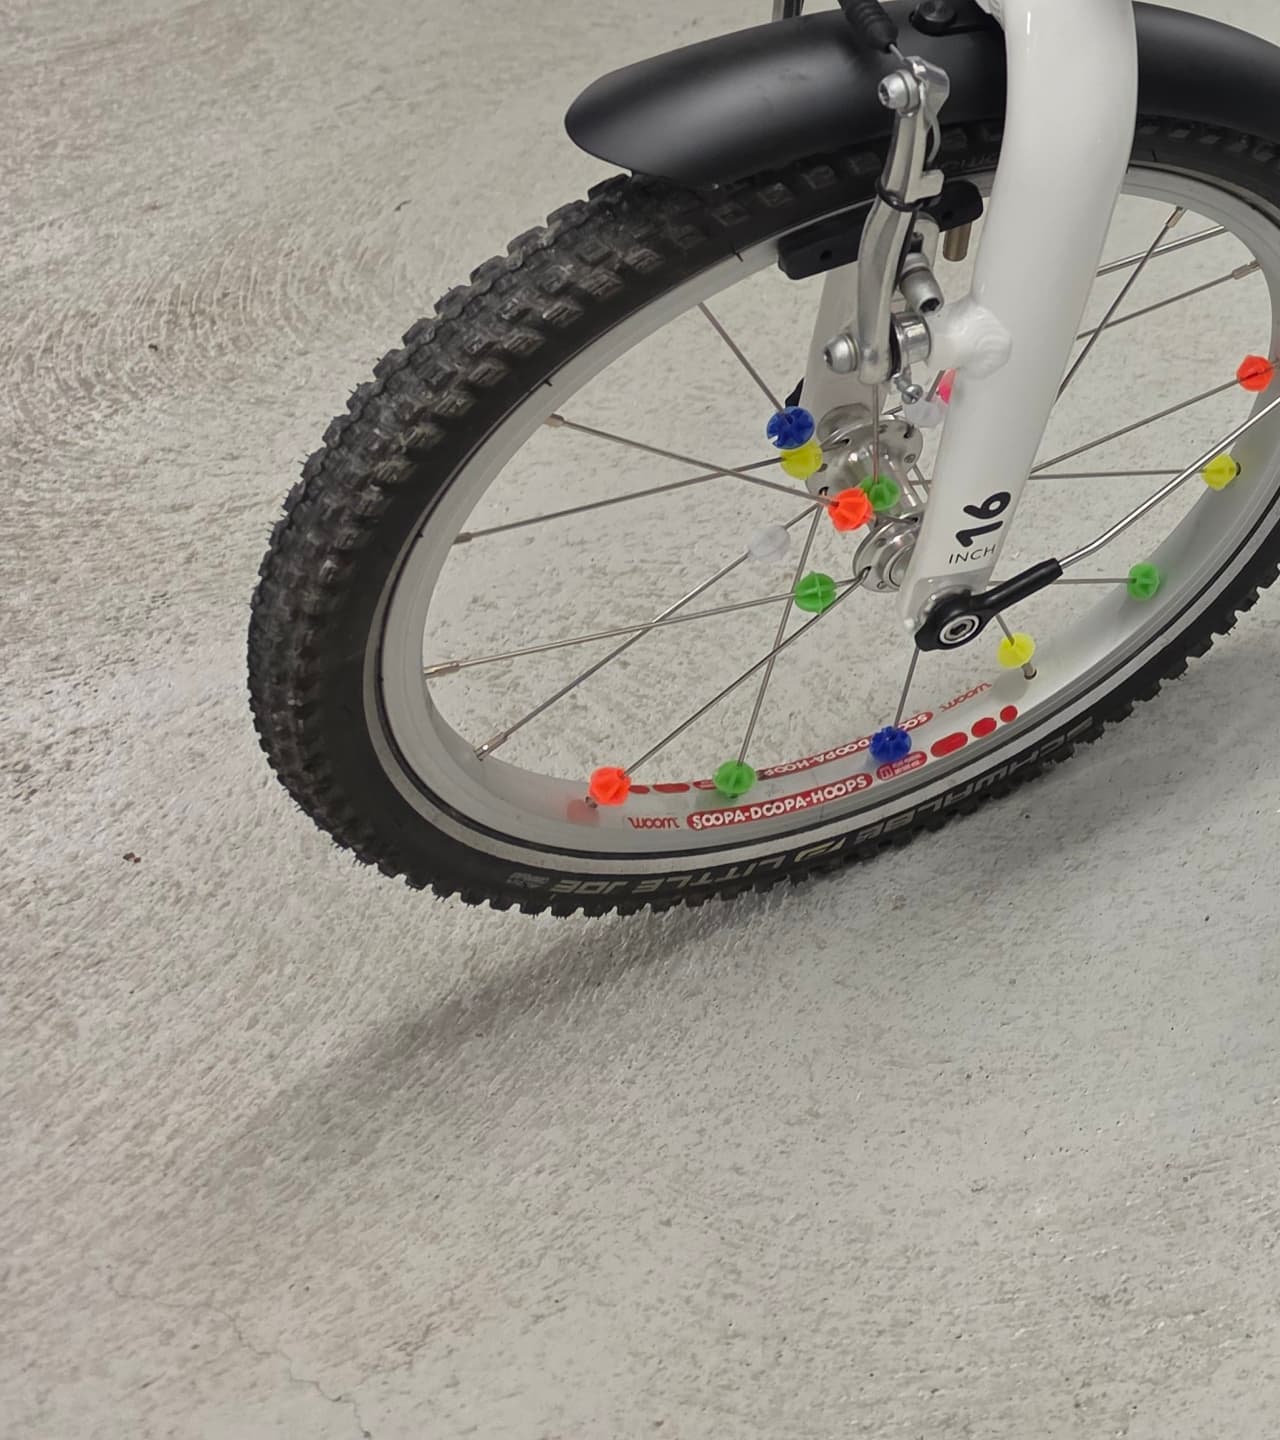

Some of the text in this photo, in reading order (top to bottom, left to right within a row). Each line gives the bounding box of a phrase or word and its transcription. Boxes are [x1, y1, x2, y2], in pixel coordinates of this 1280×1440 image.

[955, 491, 1011, 548] 16
[948, 544, 996, 565] INCH
[628, 774, 868, 830] woom SOOPA-DOOPA-HOOPS
[550, 879, 627, 896] JOE
[632, 855, 786, 894] LITTLE
